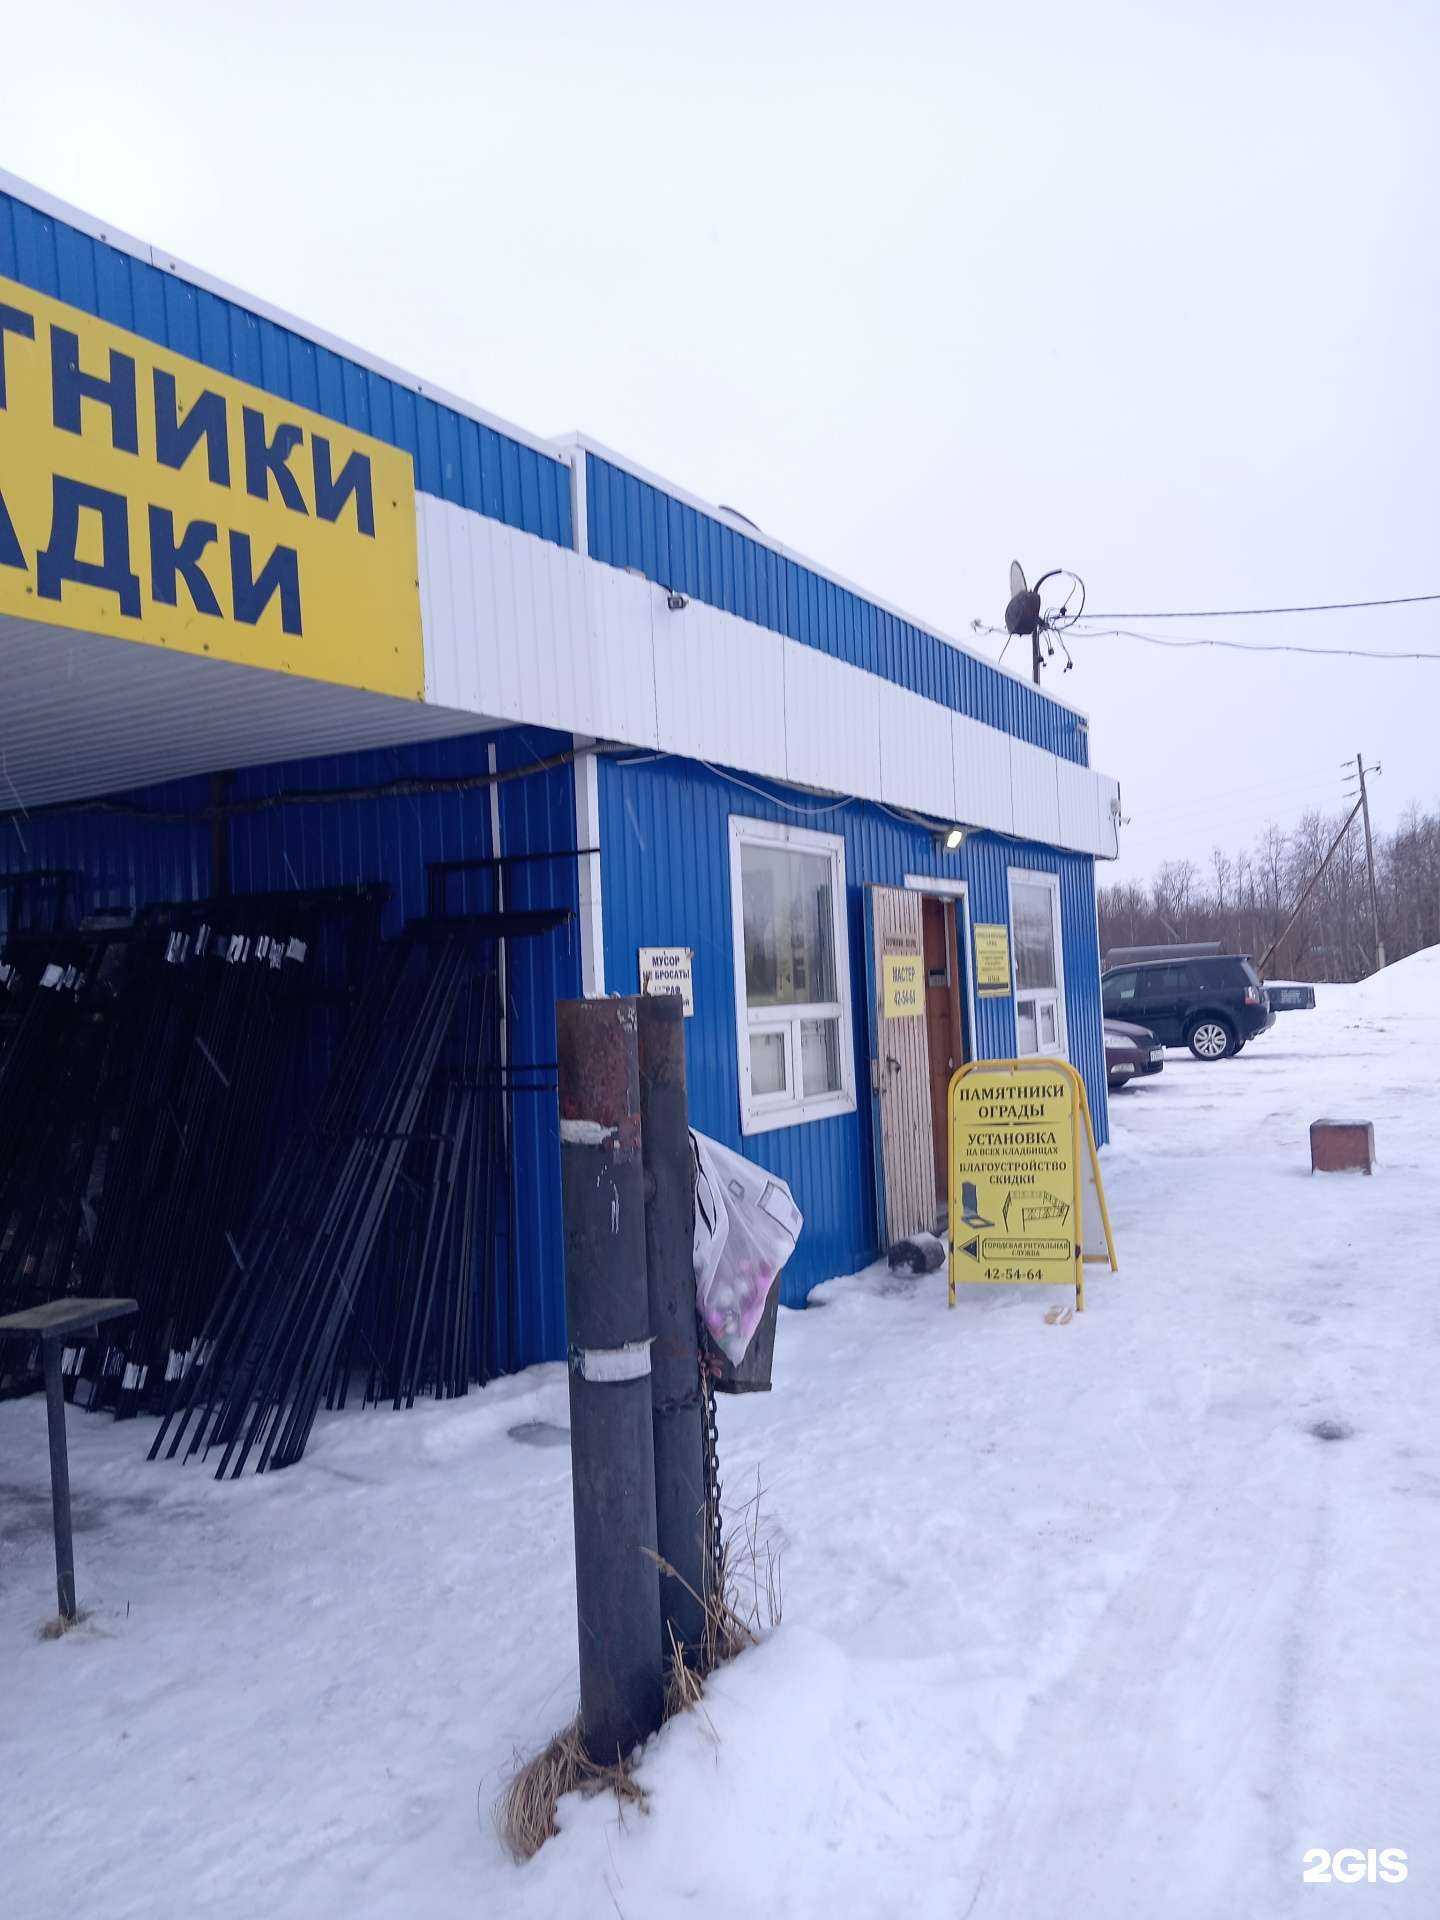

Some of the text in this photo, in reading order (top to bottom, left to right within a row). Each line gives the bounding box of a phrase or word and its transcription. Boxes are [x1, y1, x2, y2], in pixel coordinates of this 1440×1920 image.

[652, 956, 680, 967] МУСОР
[892, 966, 916, 982] МАСТЕР
[960, 1084, 1065, 1101] ПАМЯТНИКИ
[978, 1105, 1045, 1120] ОГРАДЫ
[968, 1132, 1056, 1146] УСТАНОВКА
[1002, 1147, 1059, 1156] КЛАДБИЩАХ
[960, 1160, 1067, 1173] БЛАГОУСТРОЙСТВО
[989, 1175, 1035, 1186] СКИДКИ
[984, 1269, 1043, 1280] 42-54-64
